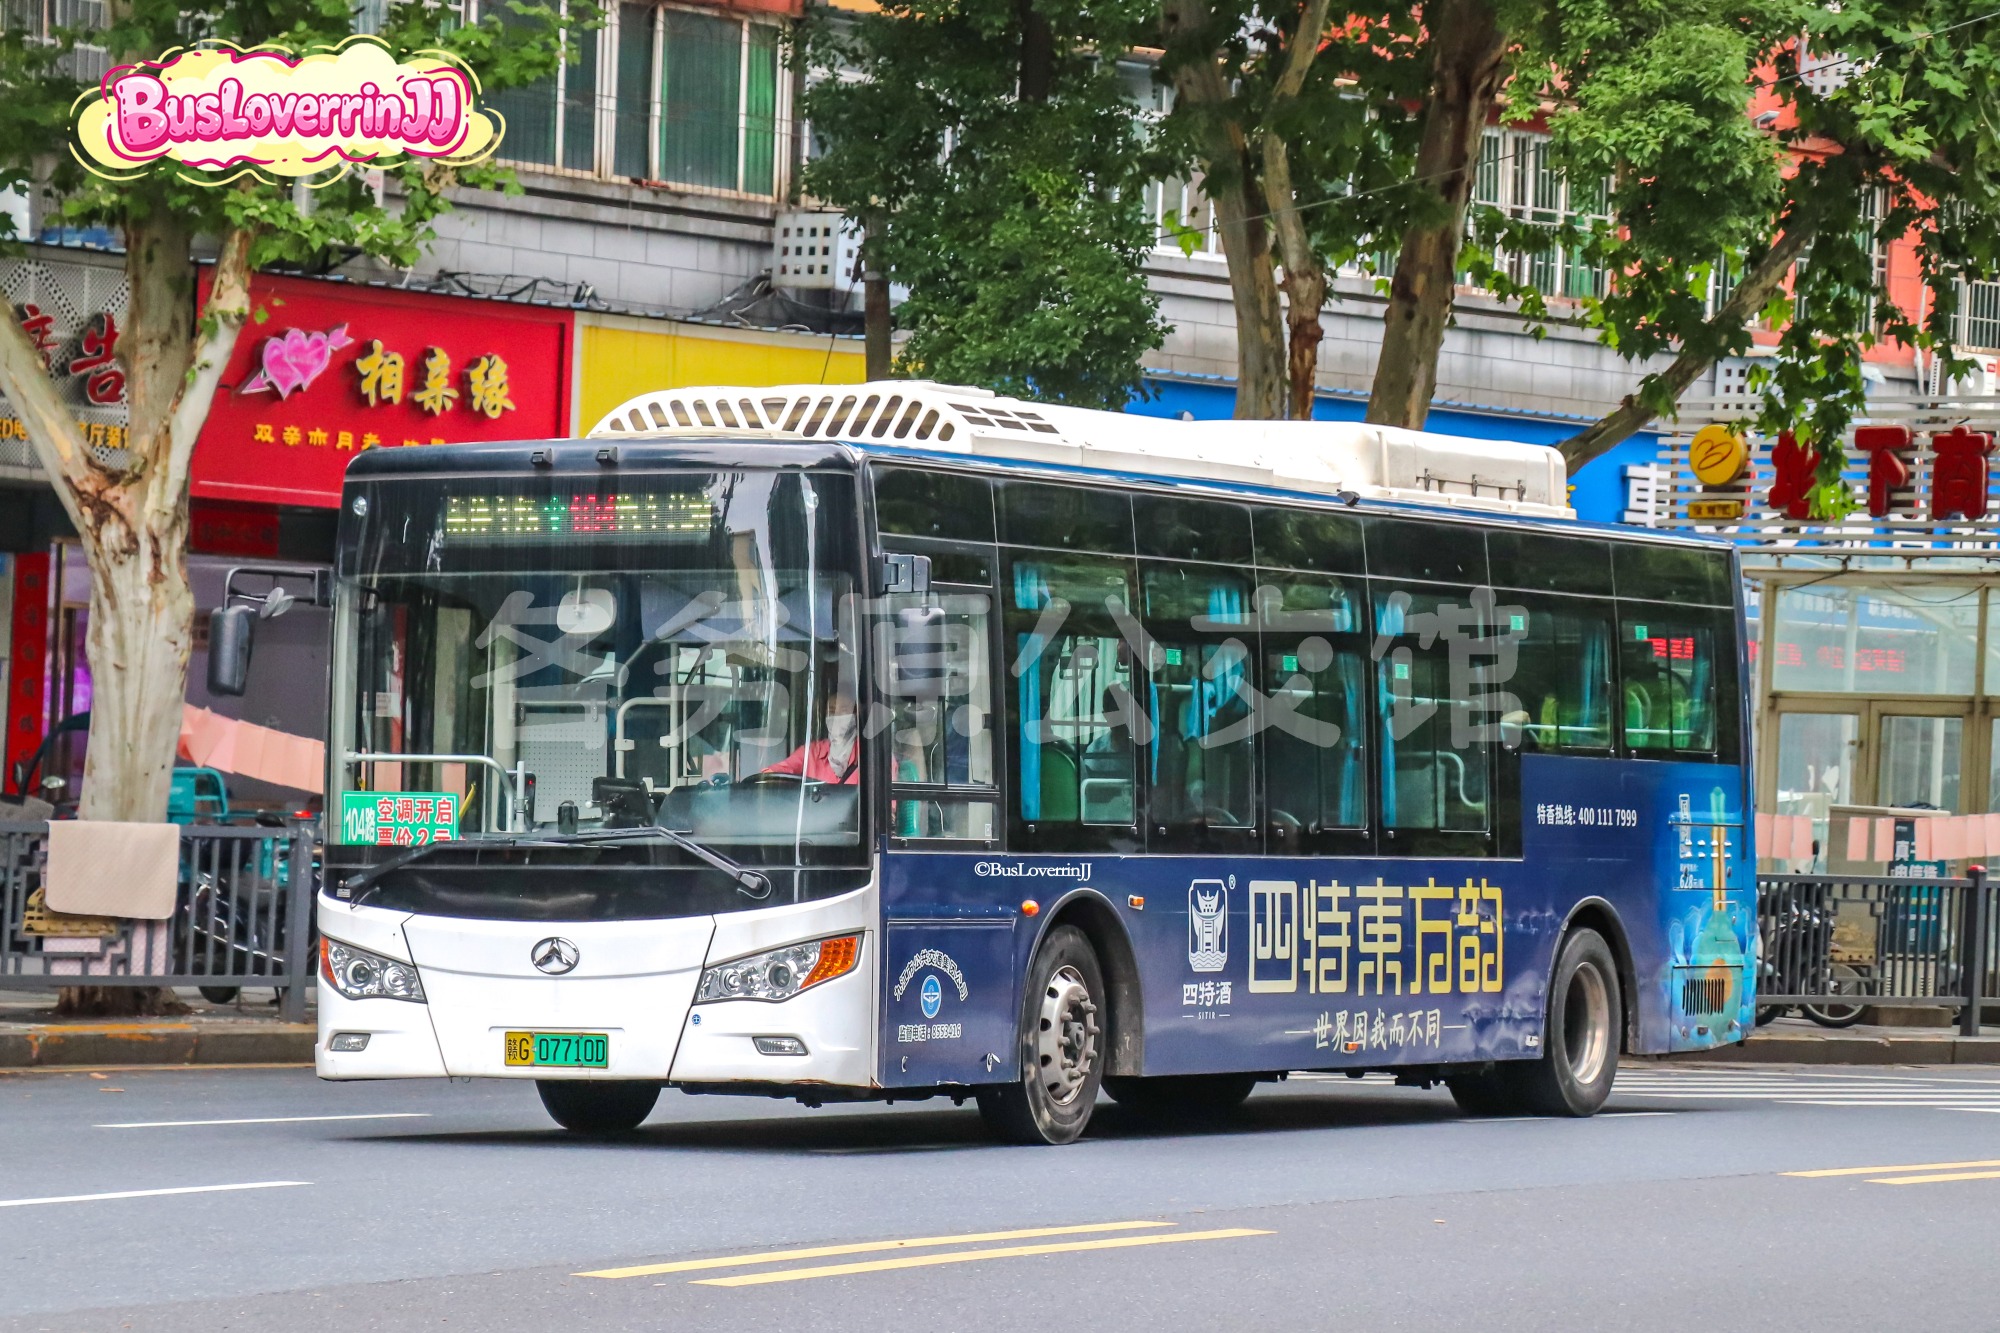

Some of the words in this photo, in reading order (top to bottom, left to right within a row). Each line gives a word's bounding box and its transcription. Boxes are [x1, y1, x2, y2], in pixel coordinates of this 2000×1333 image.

[356, 339, 516, 419] 相亲缘
[377, 797, 453, 825] 空调开启
[1578, 807, 1595, 825] 400
[1597, 808, 1613, 826] 111
[1616, 809, 1637, 827] 7999
[1182, 980, 1232, 1007] 四特酒
[1312, 1007, 1441, 1053] 世界因我而不同
